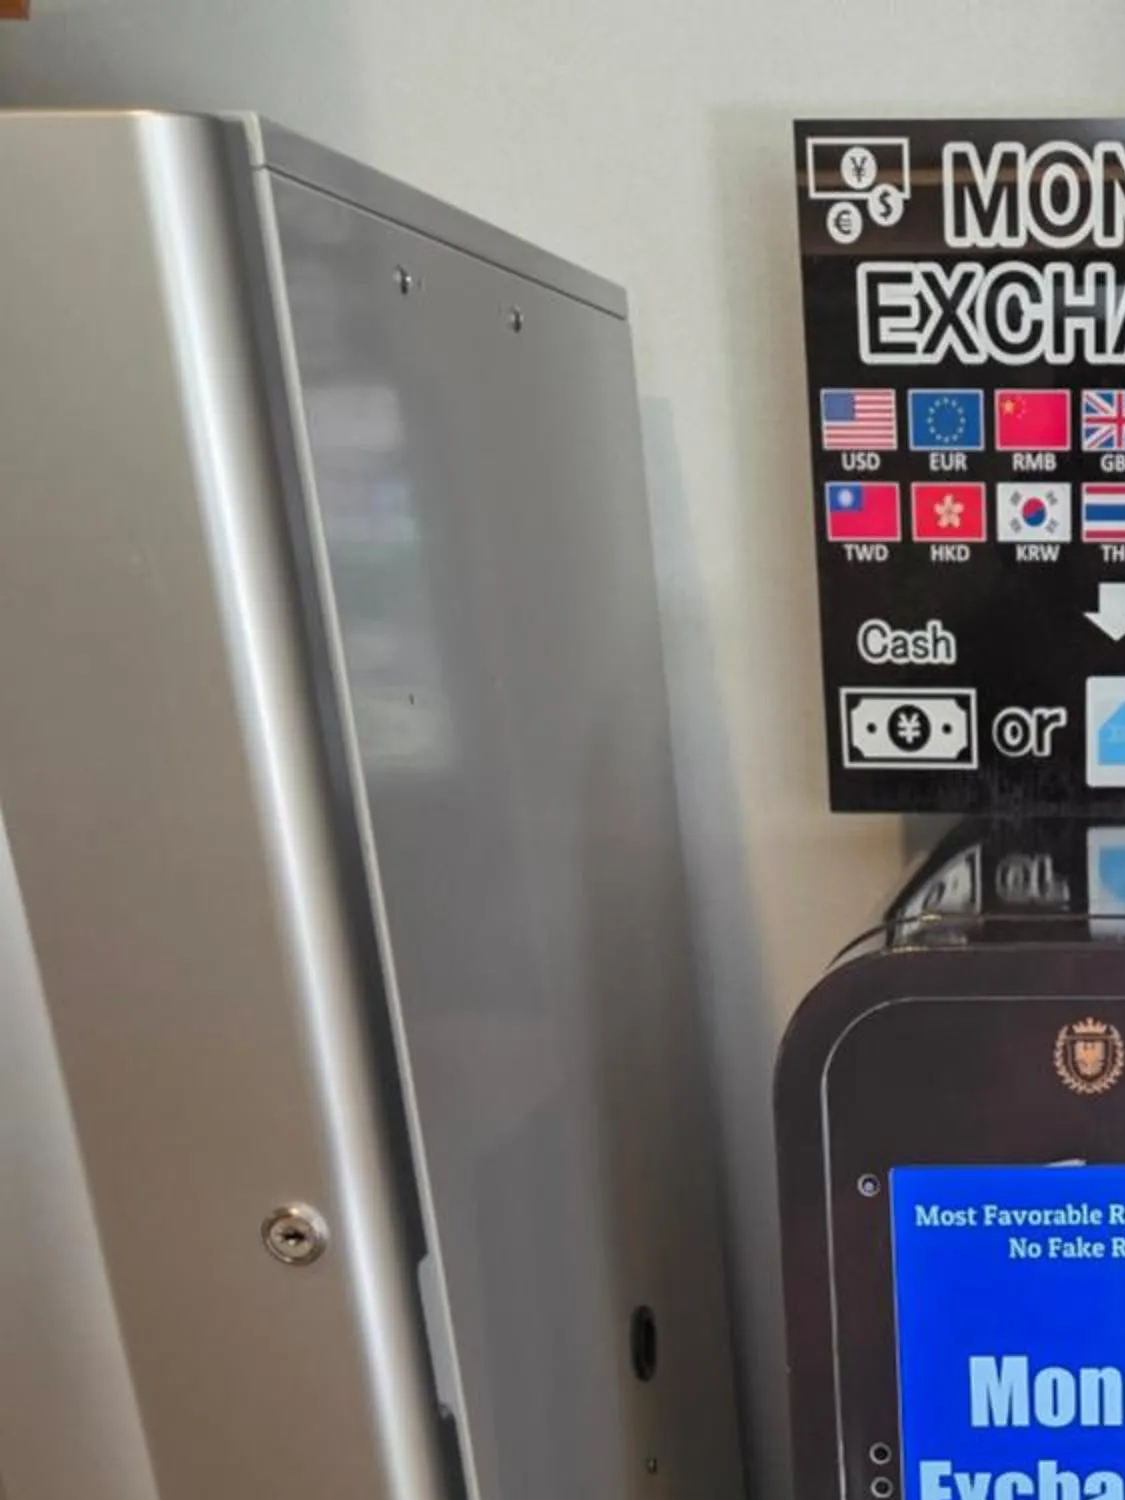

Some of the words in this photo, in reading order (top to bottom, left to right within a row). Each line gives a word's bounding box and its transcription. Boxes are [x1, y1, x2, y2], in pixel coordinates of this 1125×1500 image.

[841, 454, 881, 471] USD
[929, 454, 968, 471] EUR
[1013, 454, 1057, 471] RMB
[844, 544, 889, 562] TWD
[930, 544, 971, 562] HKD
[1016, 544, 1060, 562] KRW
[857, 620, 956, 665] Cash
[992, 707, 1067, 757] or
[914, 1204, 978, 1227] Most
[983, 1203, 1104, 1227] Favorable
[1009, 1238, 1042, 1259] No
[1048, 1237, 1105, 1258] Fake
